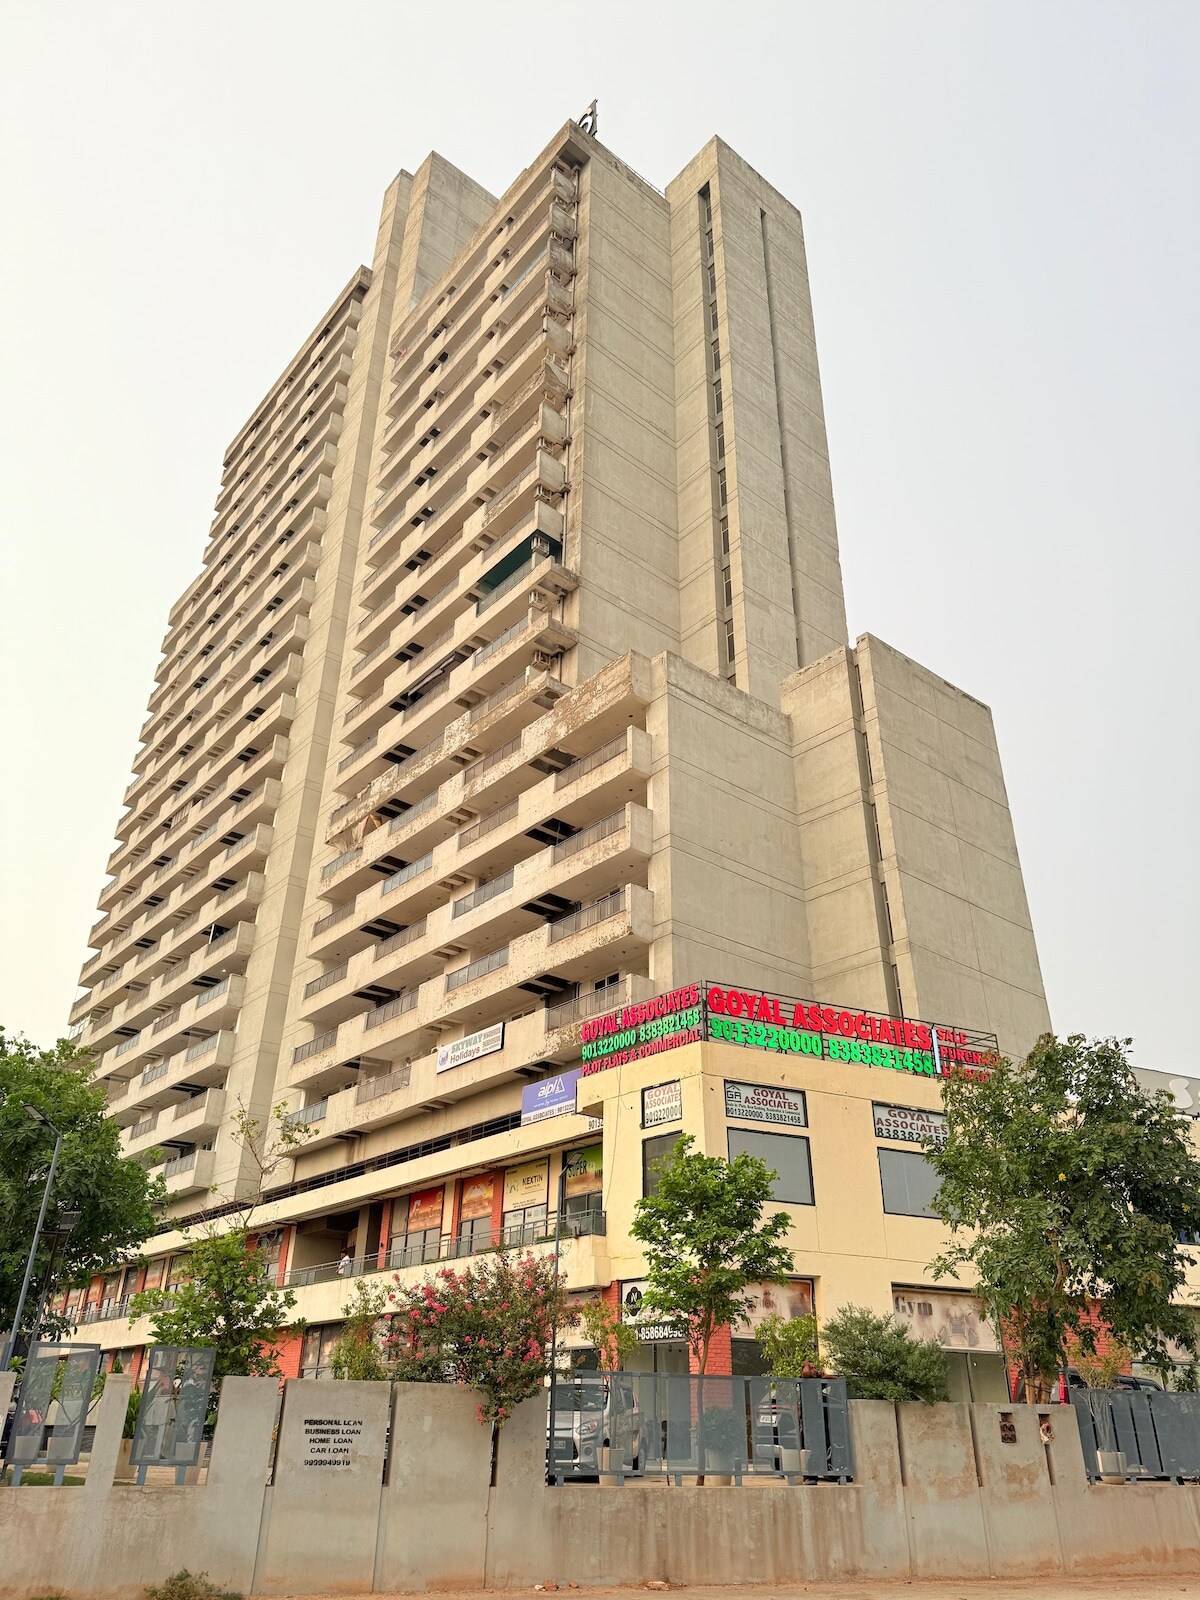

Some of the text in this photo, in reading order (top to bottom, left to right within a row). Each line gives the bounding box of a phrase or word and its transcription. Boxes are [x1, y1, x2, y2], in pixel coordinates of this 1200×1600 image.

[580, 984, 699, 1042] GOYAL ASSOCIATES
[708, 986, 932, 1050] GOYAL ASSOCIATES
[451, 1033, 482, 1053] SKYWAY
[582, 1008, 700, 1061] 9013220000 8383821458
[936, 1027, 967, 1045] SALE
[629, 1048, 637, 1060] &
[638, 1029, 700, 1058] COMMERCIAL
[710, 1017, 822, 1056] 9013220000
[828, 1038, 934, 1075] 8383821458
[450, 1046, 480, 1064] Holidays
[940, 1046, 1001, 1068] PURCH
[647, 1084, 680, 1100] GOYAL
[753, 1088, 789, 1101] GOYAL
[744, 1096, 799, 1111] ASSOCIATES
[765, 1112, 801, 1124] 8383821458
[888, 1109, 934, 1124] GOYAL
[876, 1117, 948, 1136] ASSOCIATES
[894, 1296, 933, 1317] Gym
